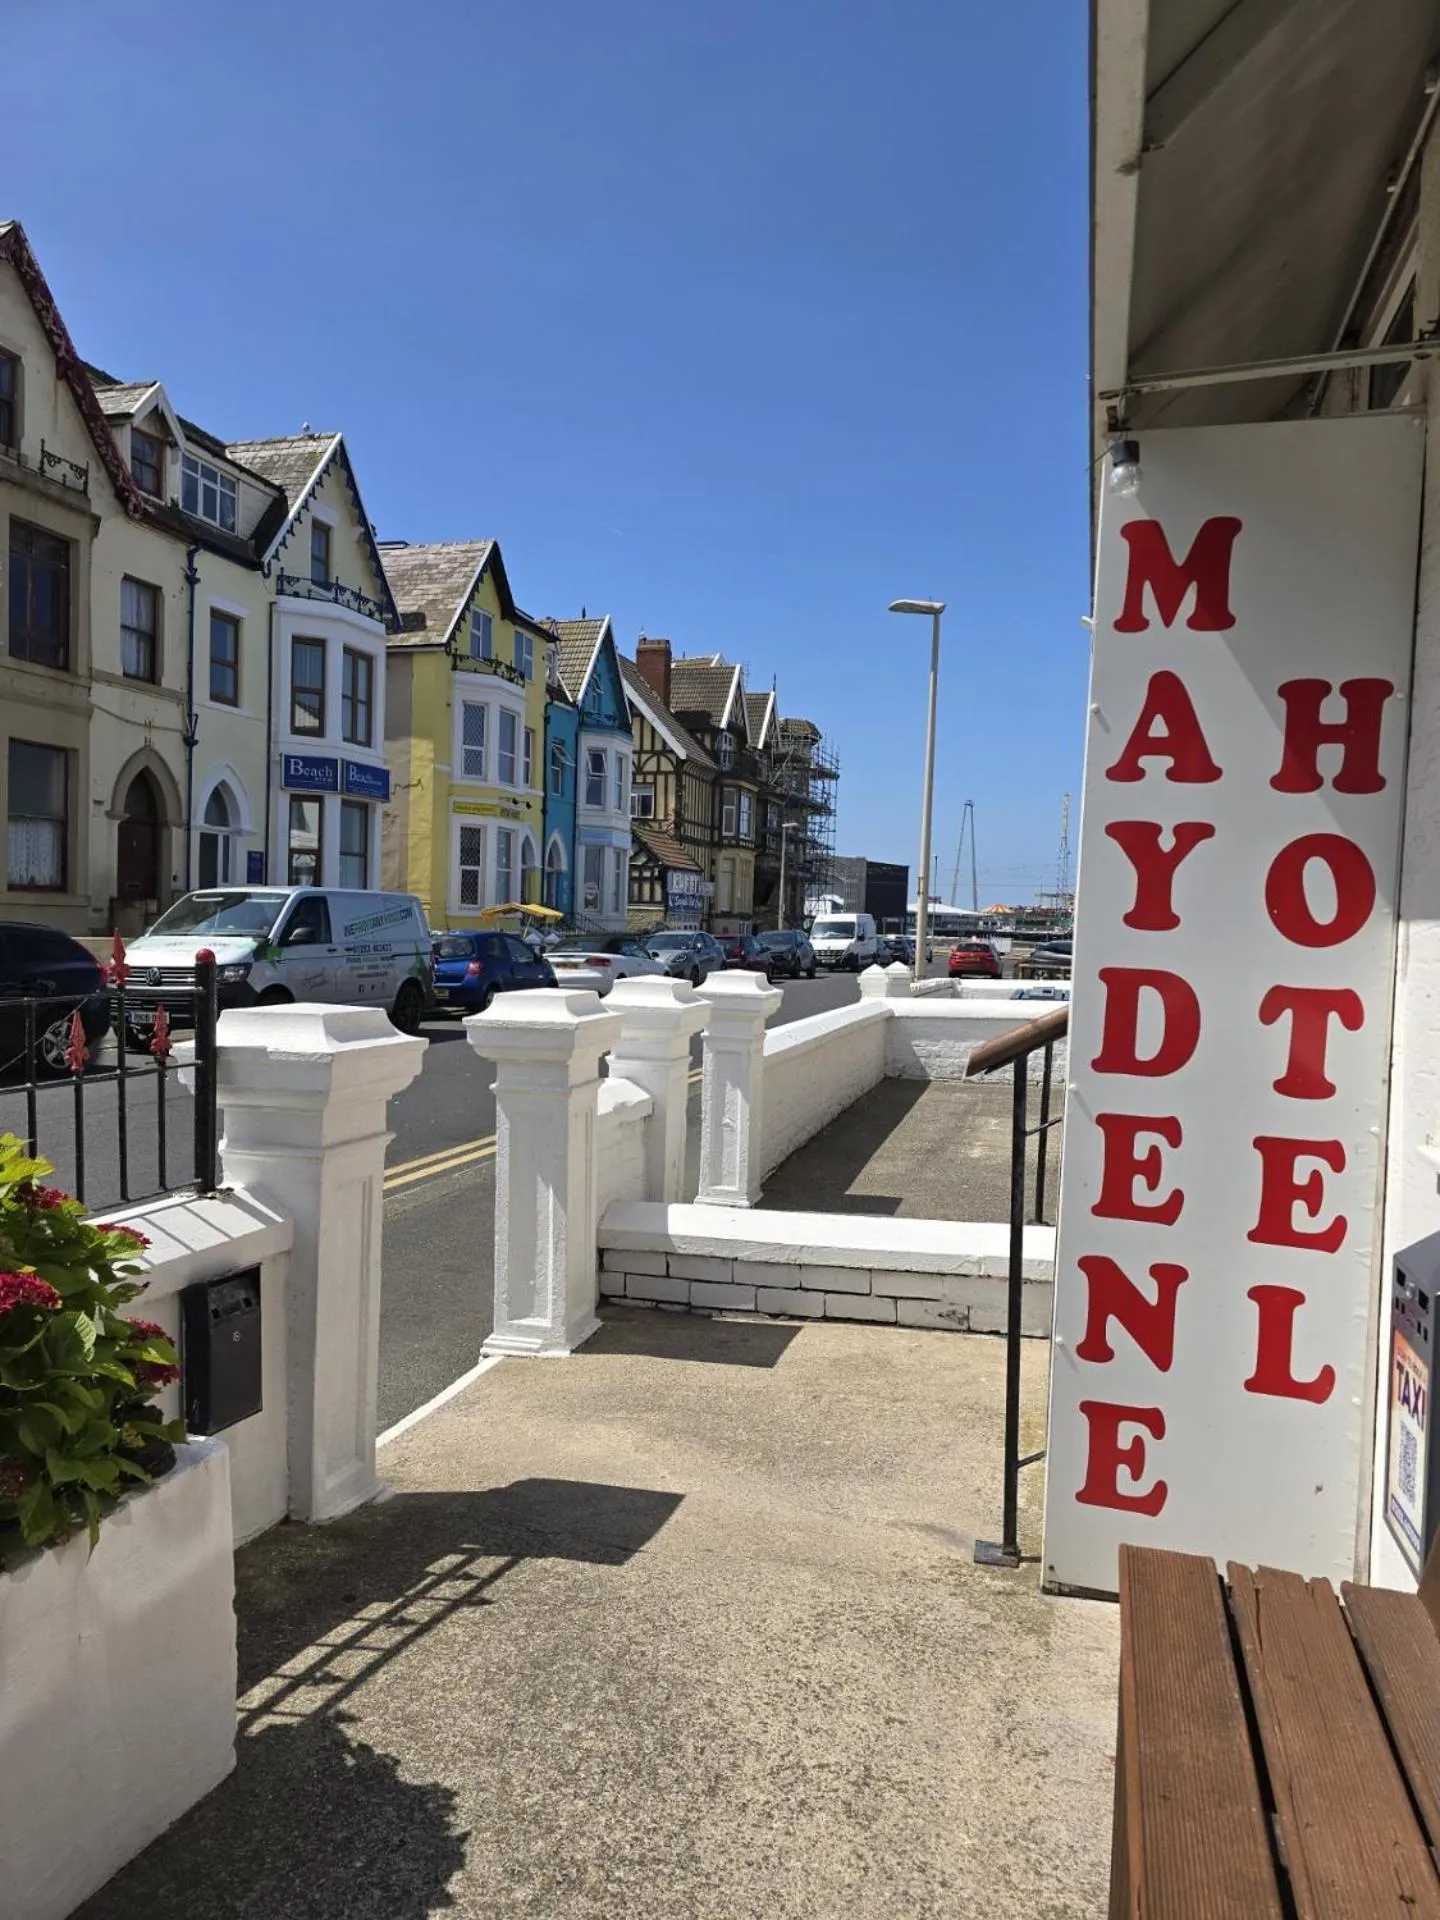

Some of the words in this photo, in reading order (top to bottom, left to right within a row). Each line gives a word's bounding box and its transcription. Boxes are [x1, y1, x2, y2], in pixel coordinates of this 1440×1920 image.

[289, 758, 333, 777] Beach
[1076, 516, 1242, 1518] MAYDENE
[1243, 678, 1394, 1405] HOTEL
[1396, 1360, 1426, 1431] TAXI
